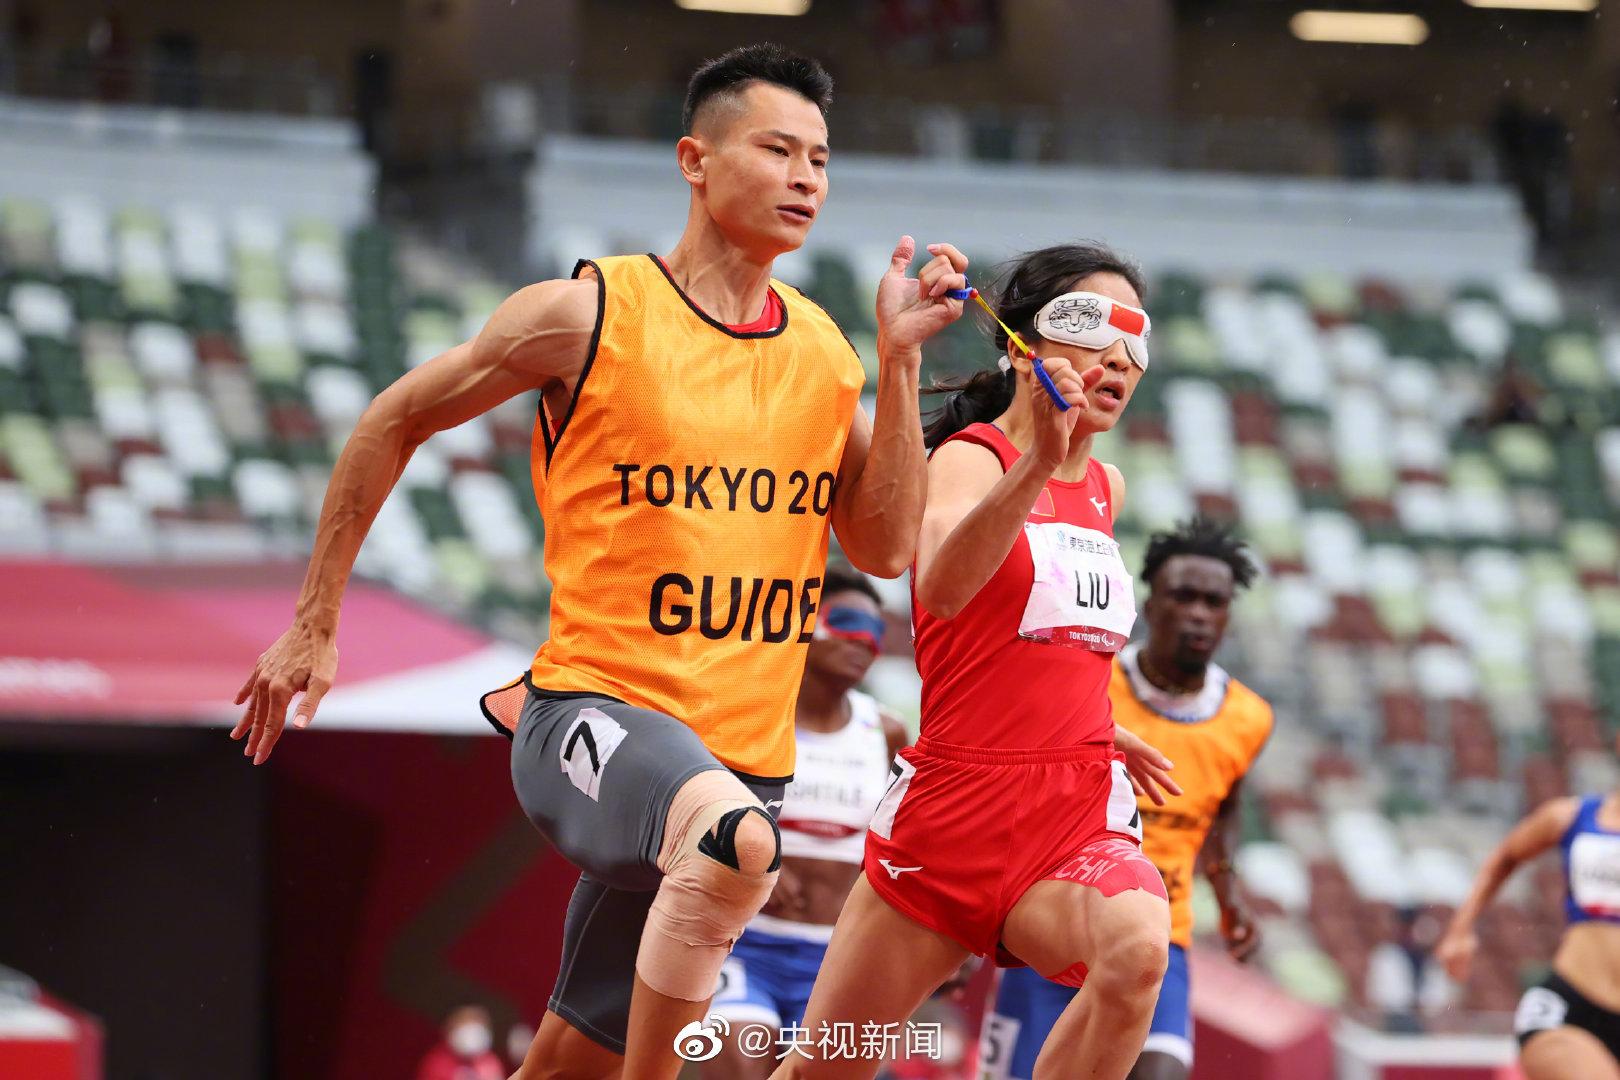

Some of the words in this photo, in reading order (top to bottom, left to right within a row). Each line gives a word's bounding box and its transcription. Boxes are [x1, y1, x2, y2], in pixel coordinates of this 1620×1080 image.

[613, 463, 776, 513] TOKYO
[649, 573, 820, 643] GUIDE
[1075, 570, 1110, 610] LIU
[563, 720, 601, 777] 7
[1055, 855, 1119, 884] CHN
